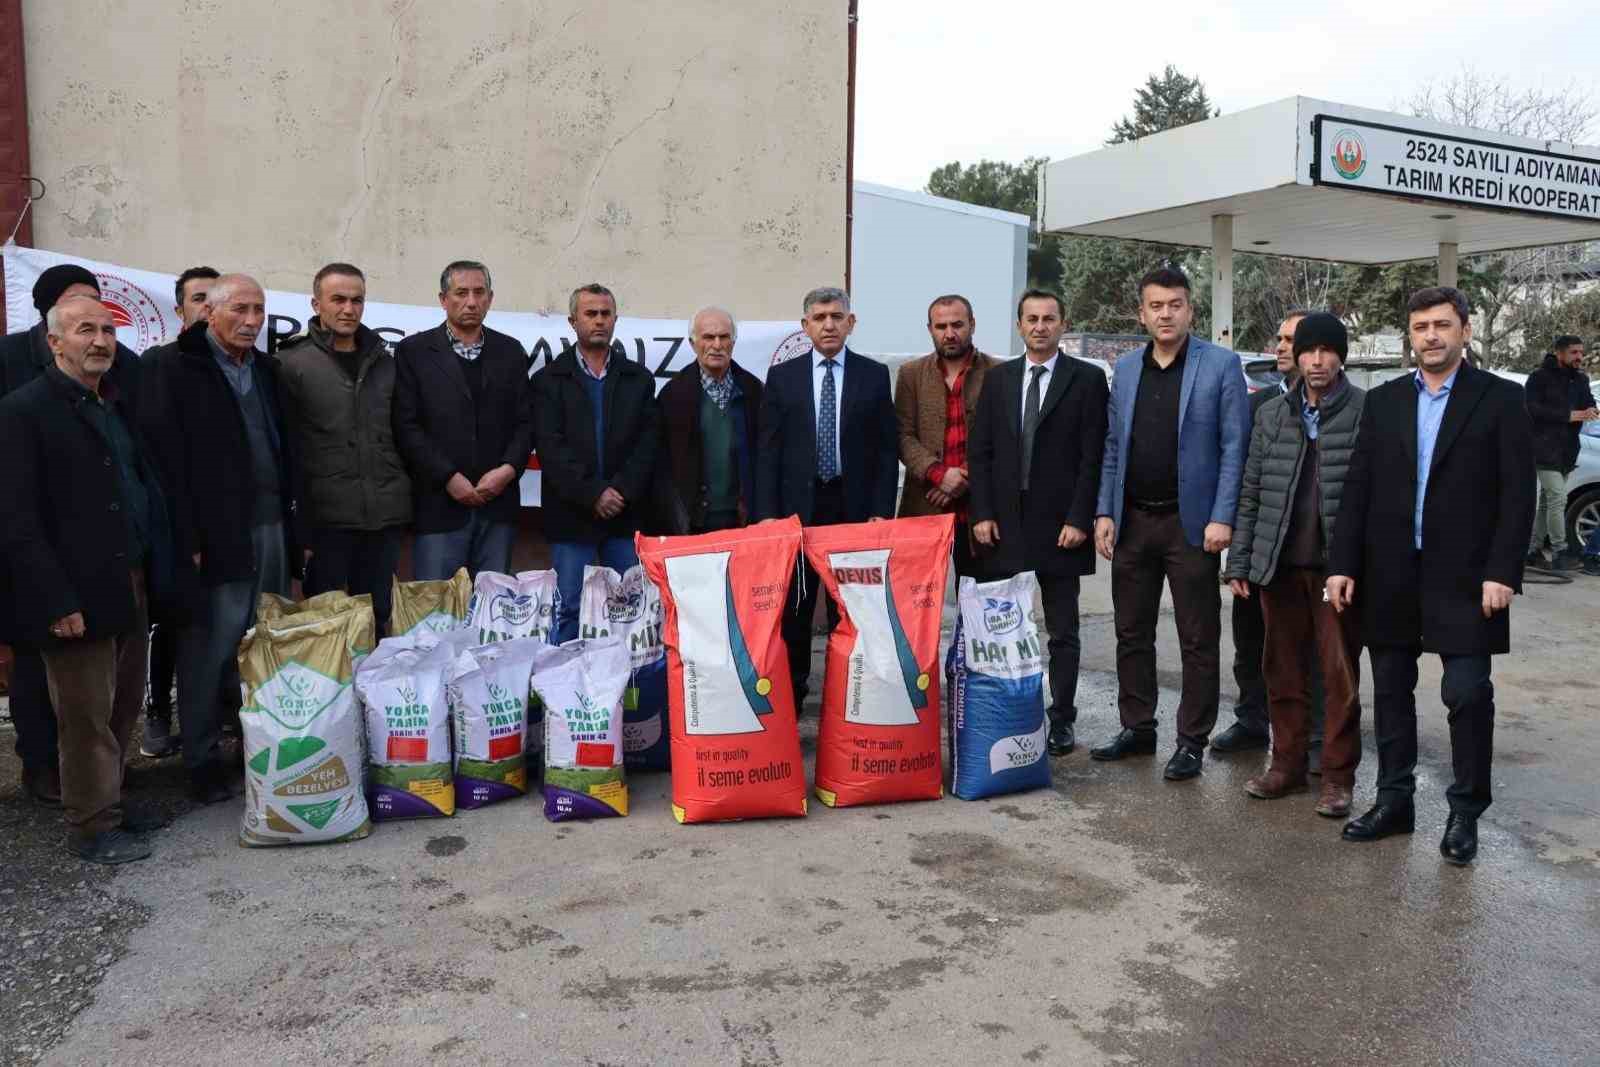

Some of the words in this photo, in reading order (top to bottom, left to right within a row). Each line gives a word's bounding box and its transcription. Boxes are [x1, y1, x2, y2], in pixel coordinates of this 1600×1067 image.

[1406, 140, 1448, 164] 2524
[1453, 147, 1509, 174] SAYILI
[1514, 159, 1600, 187] ADIYAMAN
[1384, 164, 1443, 193] TARIM
[1450, 175, 1503, 200] KREDİ
[1508, 183, 1600, 213] KOOPERAT
[837, 568, 882, 584] DEVIS
[276, 695, 320, 710] YONCA
[481, 697, 522, 715] YONCA
[384, 704, 429, 717] YONCA
[564, 707, 610, 721] YONCA
[485, 711, 523, 728] TARIM
[567, 719, 609, 732] TARIM
[879, 737, 903, 751] quality
[713, 750, 720, 760] in
[722, 749, 749, 763] quality
[852, 753, 859, 772] il
[863, 756, 897, 773] seme
[900, 751, 937, 773] evoluto
[1006, 752, 1039, 761] YONCA
[311, 767, 337, 781] YEM
[697, 767, 704, 787] il
[708, 769, 745, 787] seme
[749, 761, 792, 784] evoluto
